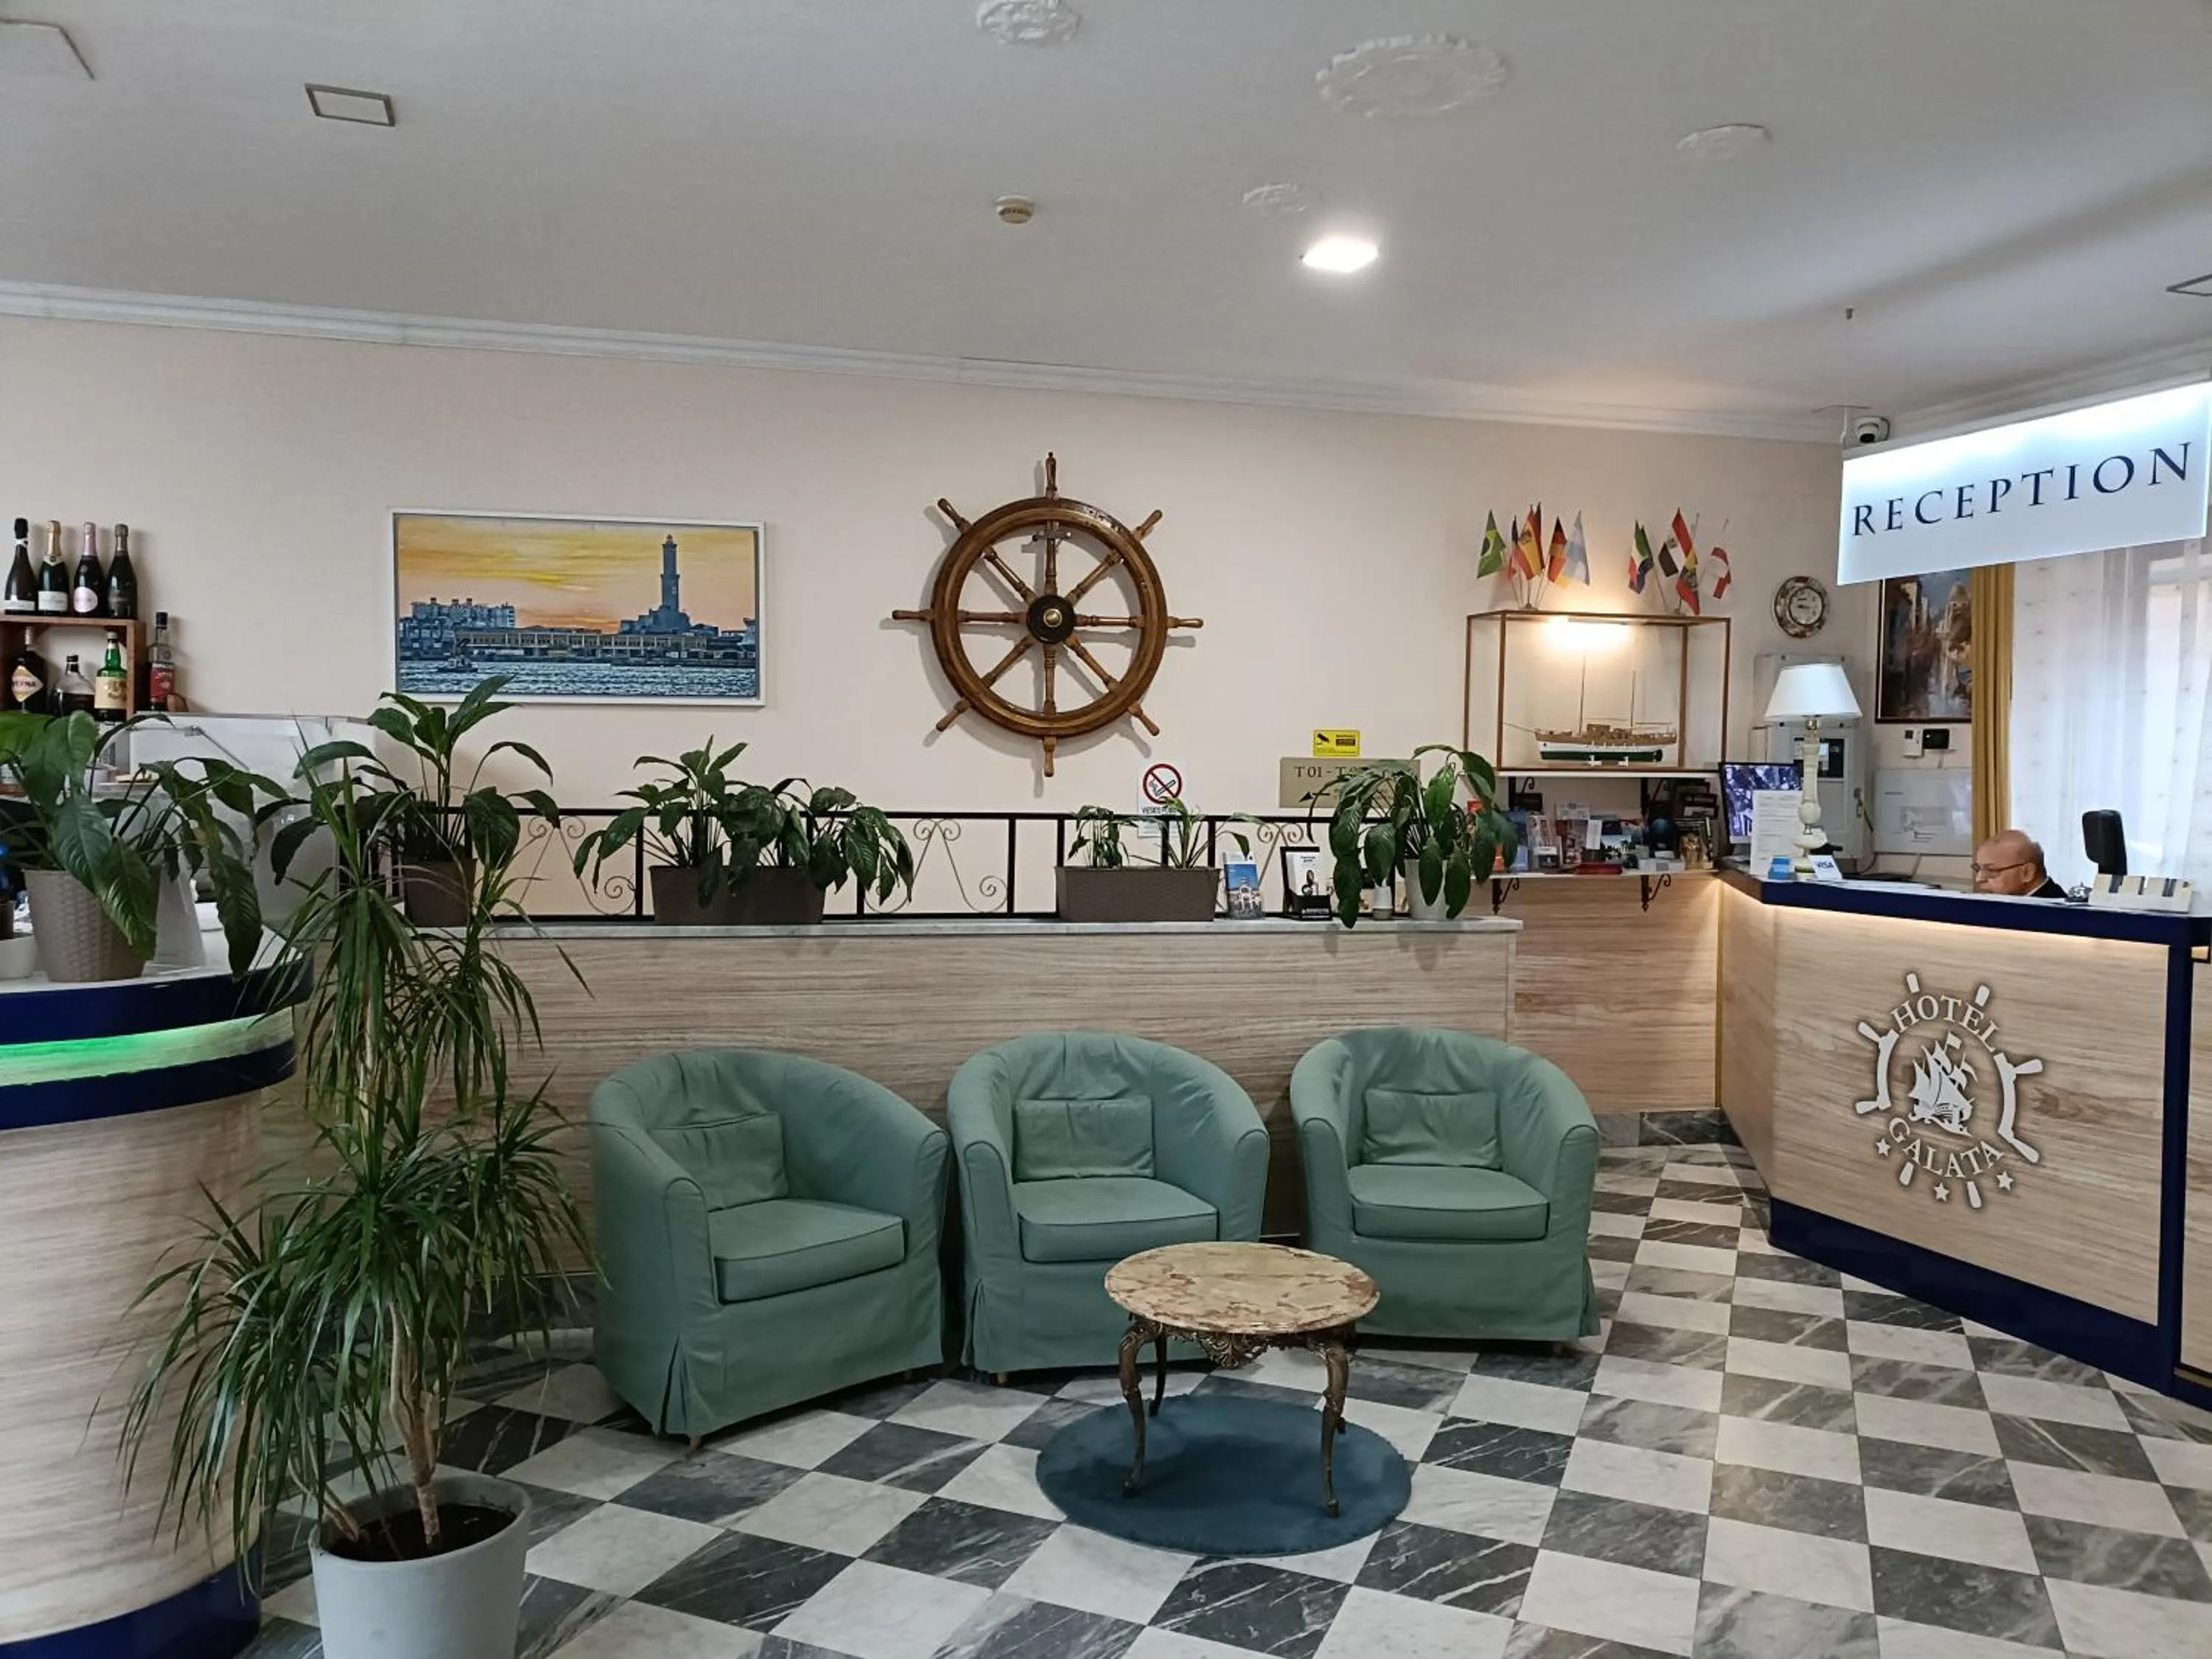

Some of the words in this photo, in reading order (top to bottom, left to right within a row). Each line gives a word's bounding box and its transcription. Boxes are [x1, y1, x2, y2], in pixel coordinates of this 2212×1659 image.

[1852, 442, 2192, 536] RECEPTION
[1815, 861, 1834, 869] VISA
[1891, 995, 2000, 1052] HOTEL
[1888, 1117, 2005, 1178] GALATA
